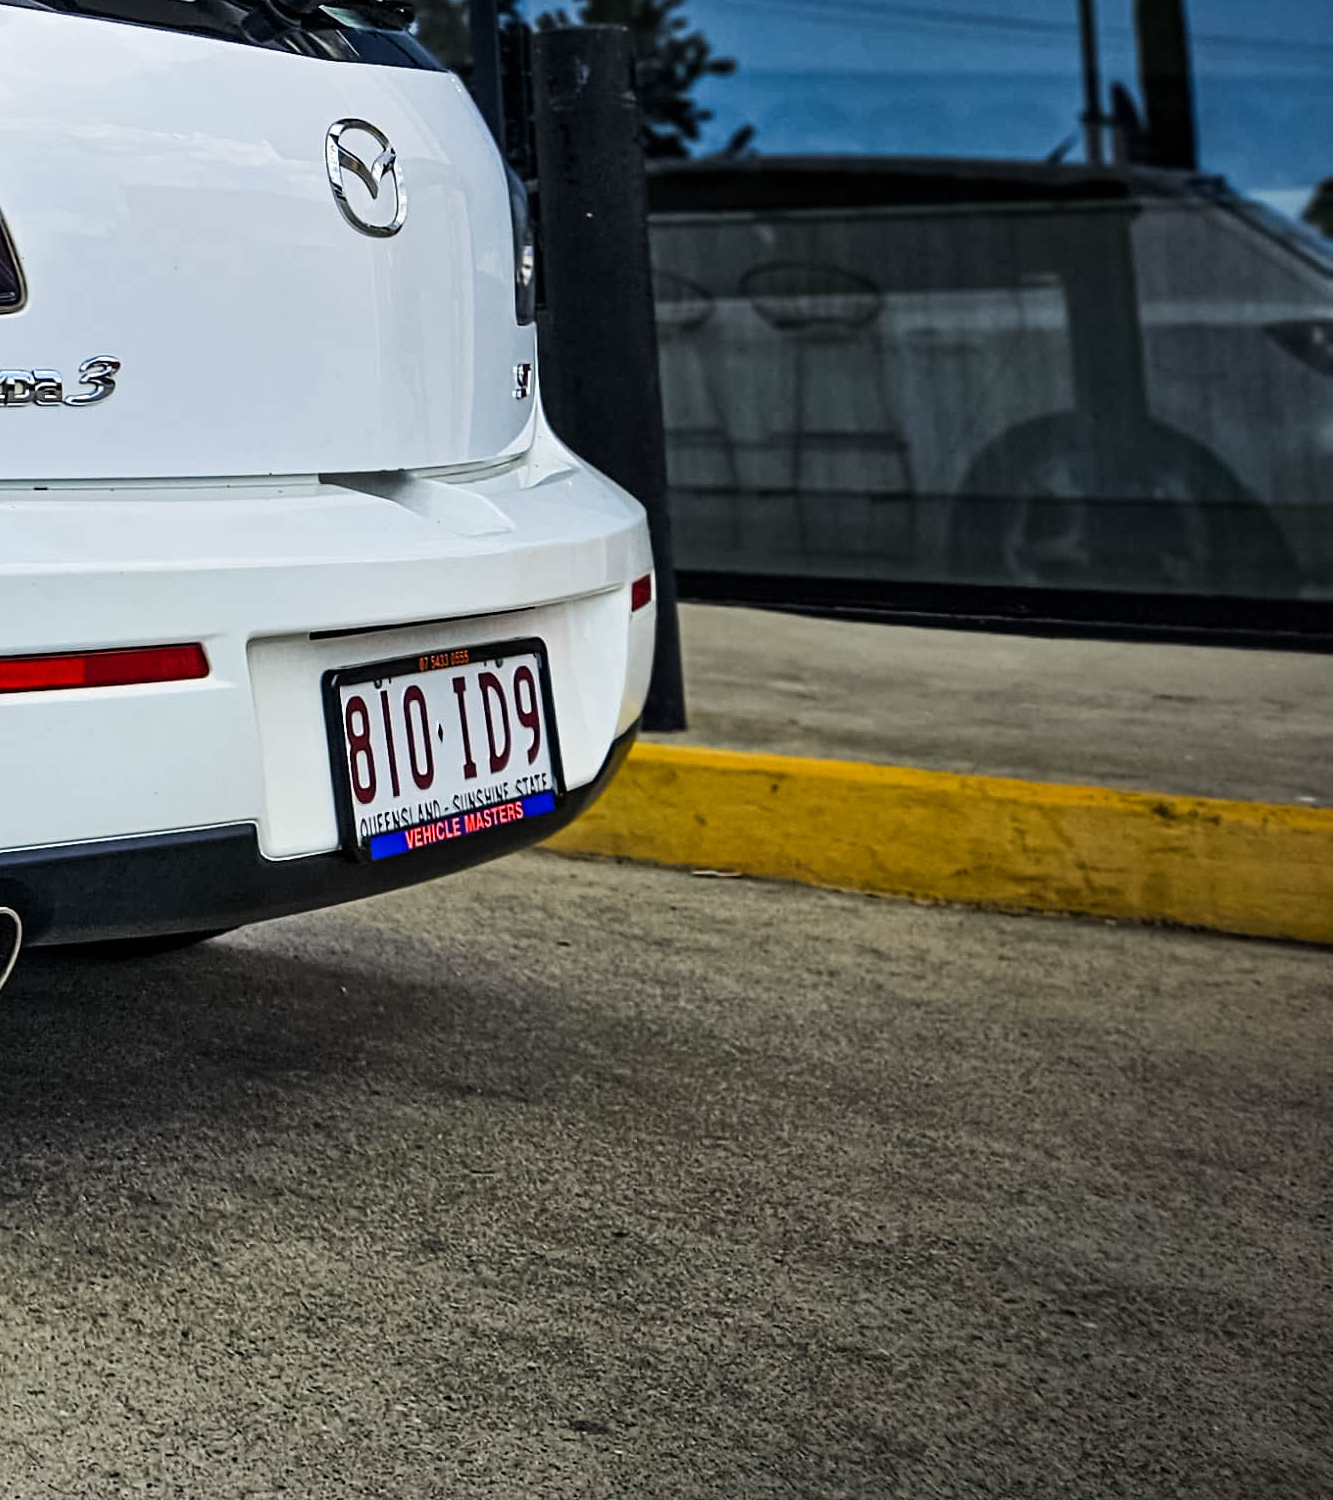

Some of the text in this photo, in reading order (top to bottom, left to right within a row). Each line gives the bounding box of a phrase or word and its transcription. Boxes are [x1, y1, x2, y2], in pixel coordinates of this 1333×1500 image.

[359, 800, 441, 837] QUEENSLAND
[452, 781, 509, 813] SUNSHINE
[515, 772, 549, 798] STATE
[405, 801, 525, 850] VEHICLE MASTERS
